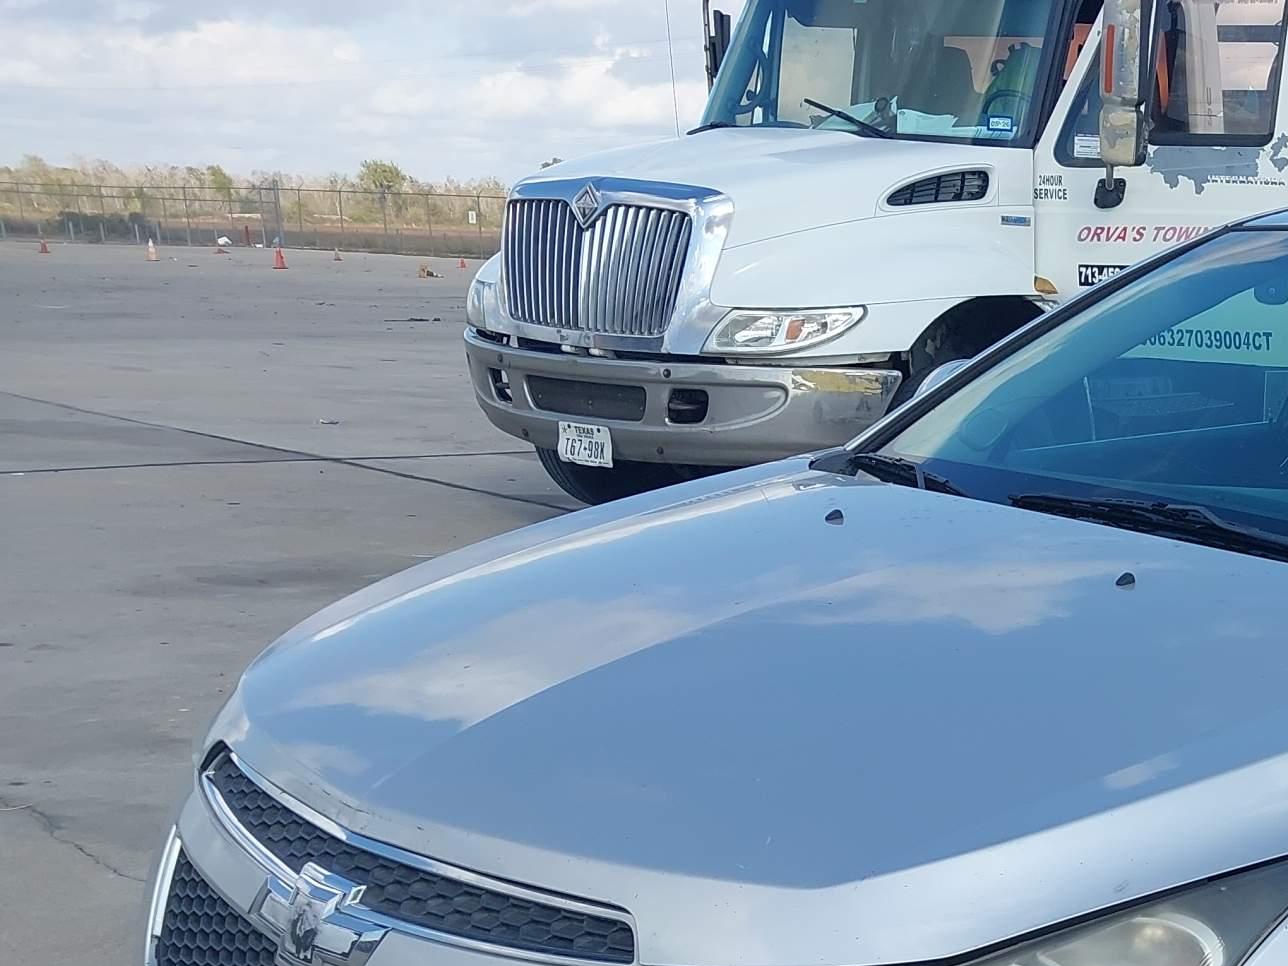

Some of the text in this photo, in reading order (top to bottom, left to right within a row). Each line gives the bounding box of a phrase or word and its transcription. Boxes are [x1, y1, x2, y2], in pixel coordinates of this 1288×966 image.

[1033, 188, 1068, 200] SERVICE
[1077, 226, 1146, 242] ORVA'S
[575, 426, 594, 435] TEXAS
